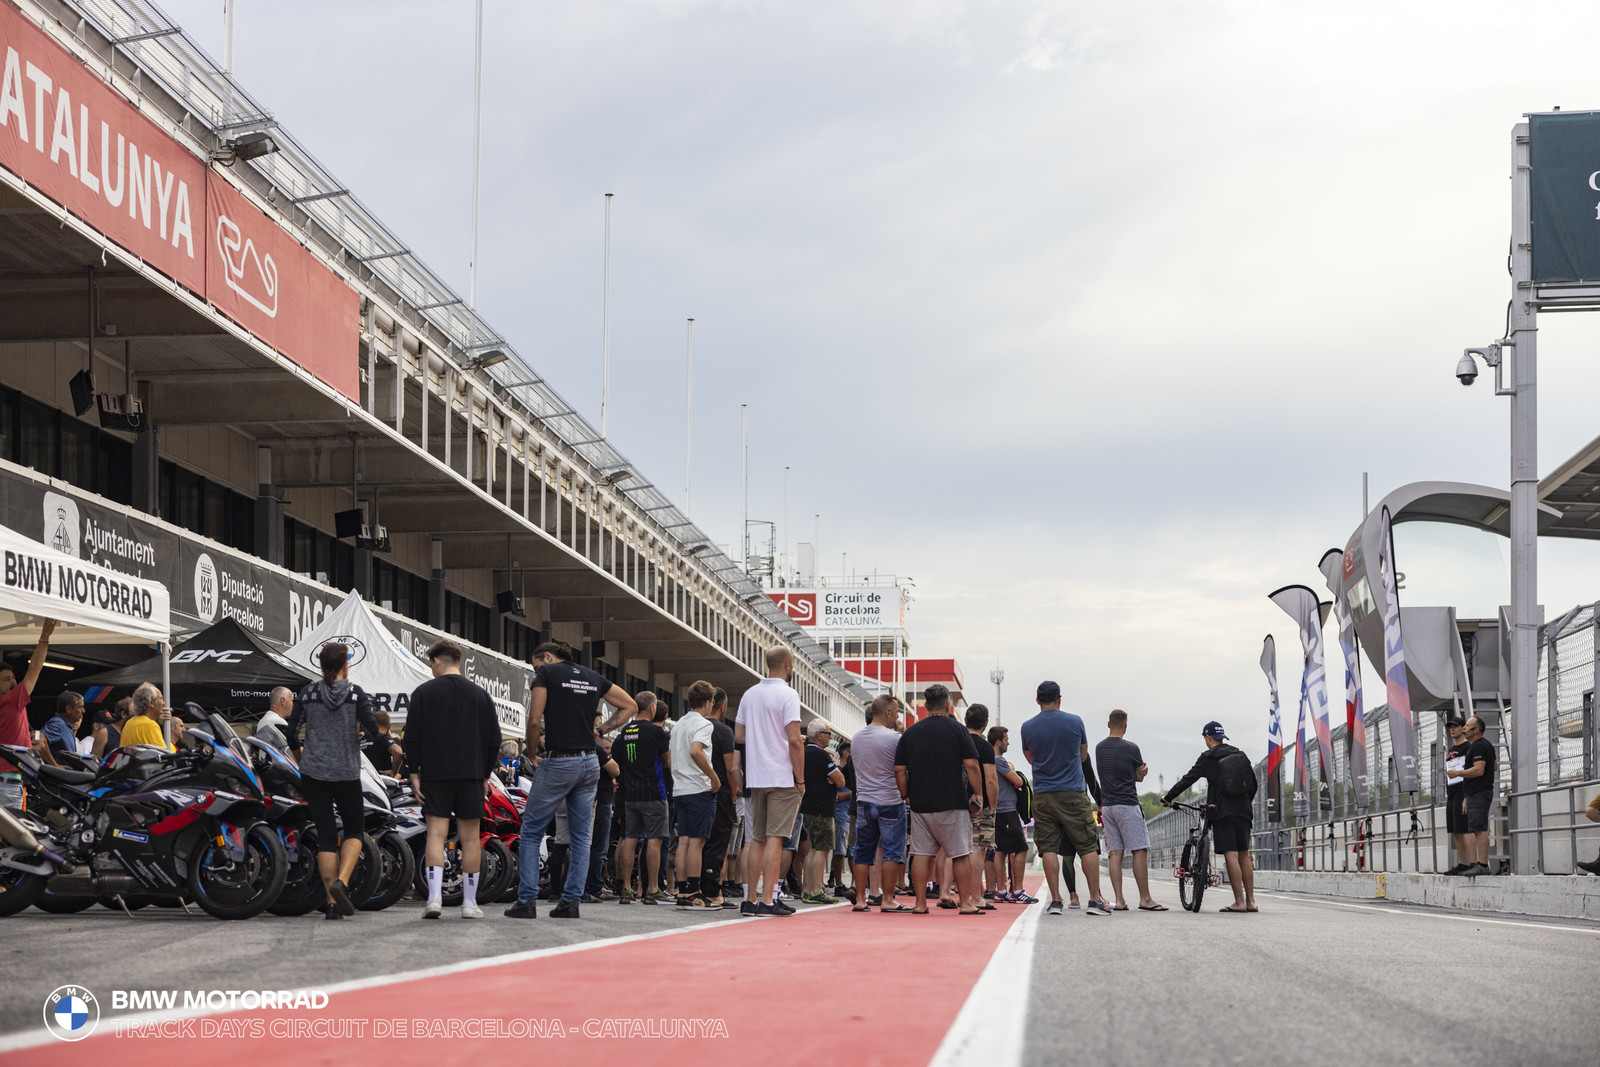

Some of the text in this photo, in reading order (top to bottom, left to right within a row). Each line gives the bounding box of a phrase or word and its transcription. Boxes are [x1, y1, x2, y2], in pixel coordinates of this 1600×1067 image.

[85, 518, 156, 567] Ajuntament
[5, 550, 53, 595] BMW
[59, 565, 153, 620] MOTORRAD
[221, 571, 264, 605] Diputació
[867, 592, 881, 603] de
[221, 599, 264, 632] Barcelona
[825, 605, 880, 615] Barcelona
[825, 617, 882, 626] CATALUNYA
[169, 649, 253, 663] BMC
